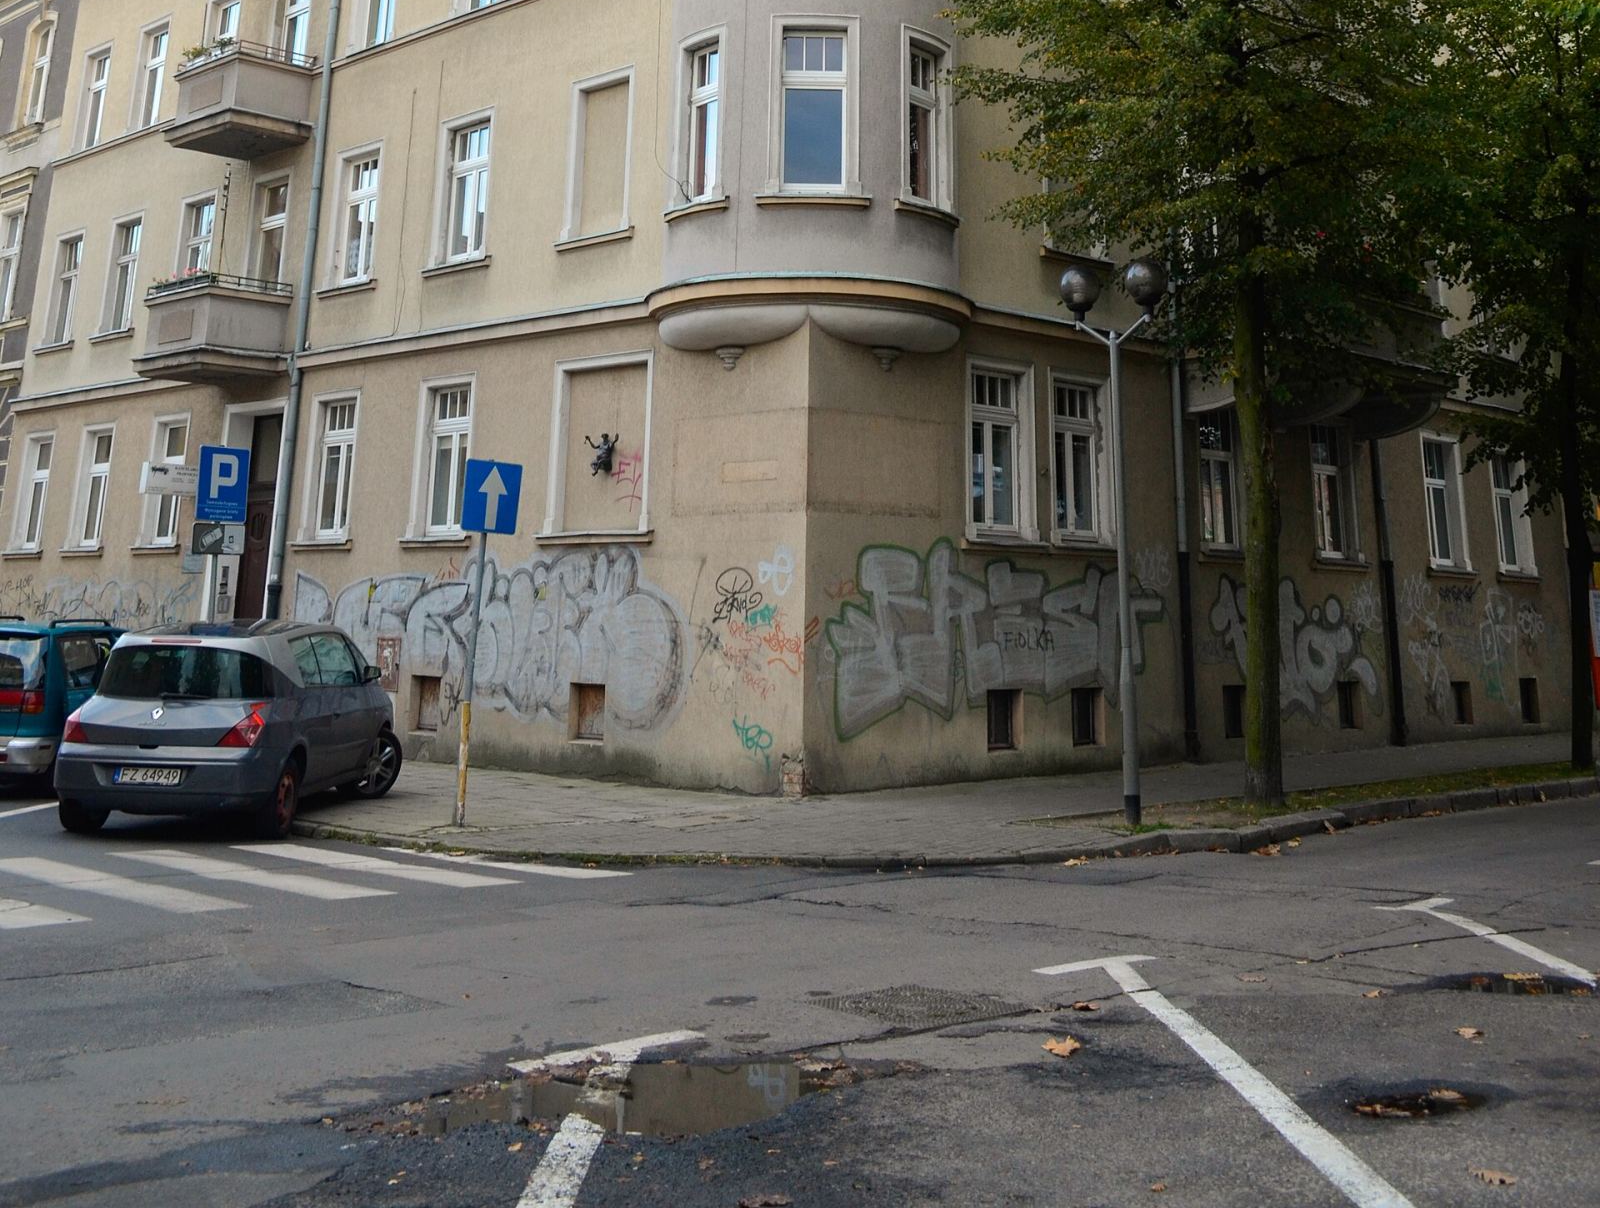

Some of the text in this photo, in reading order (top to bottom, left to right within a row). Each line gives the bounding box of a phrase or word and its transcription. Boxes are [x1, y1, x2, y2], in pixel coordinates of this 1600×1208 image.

[210, 453, 239, 498] P
[121, 768, 179, 782] FZ 64949
